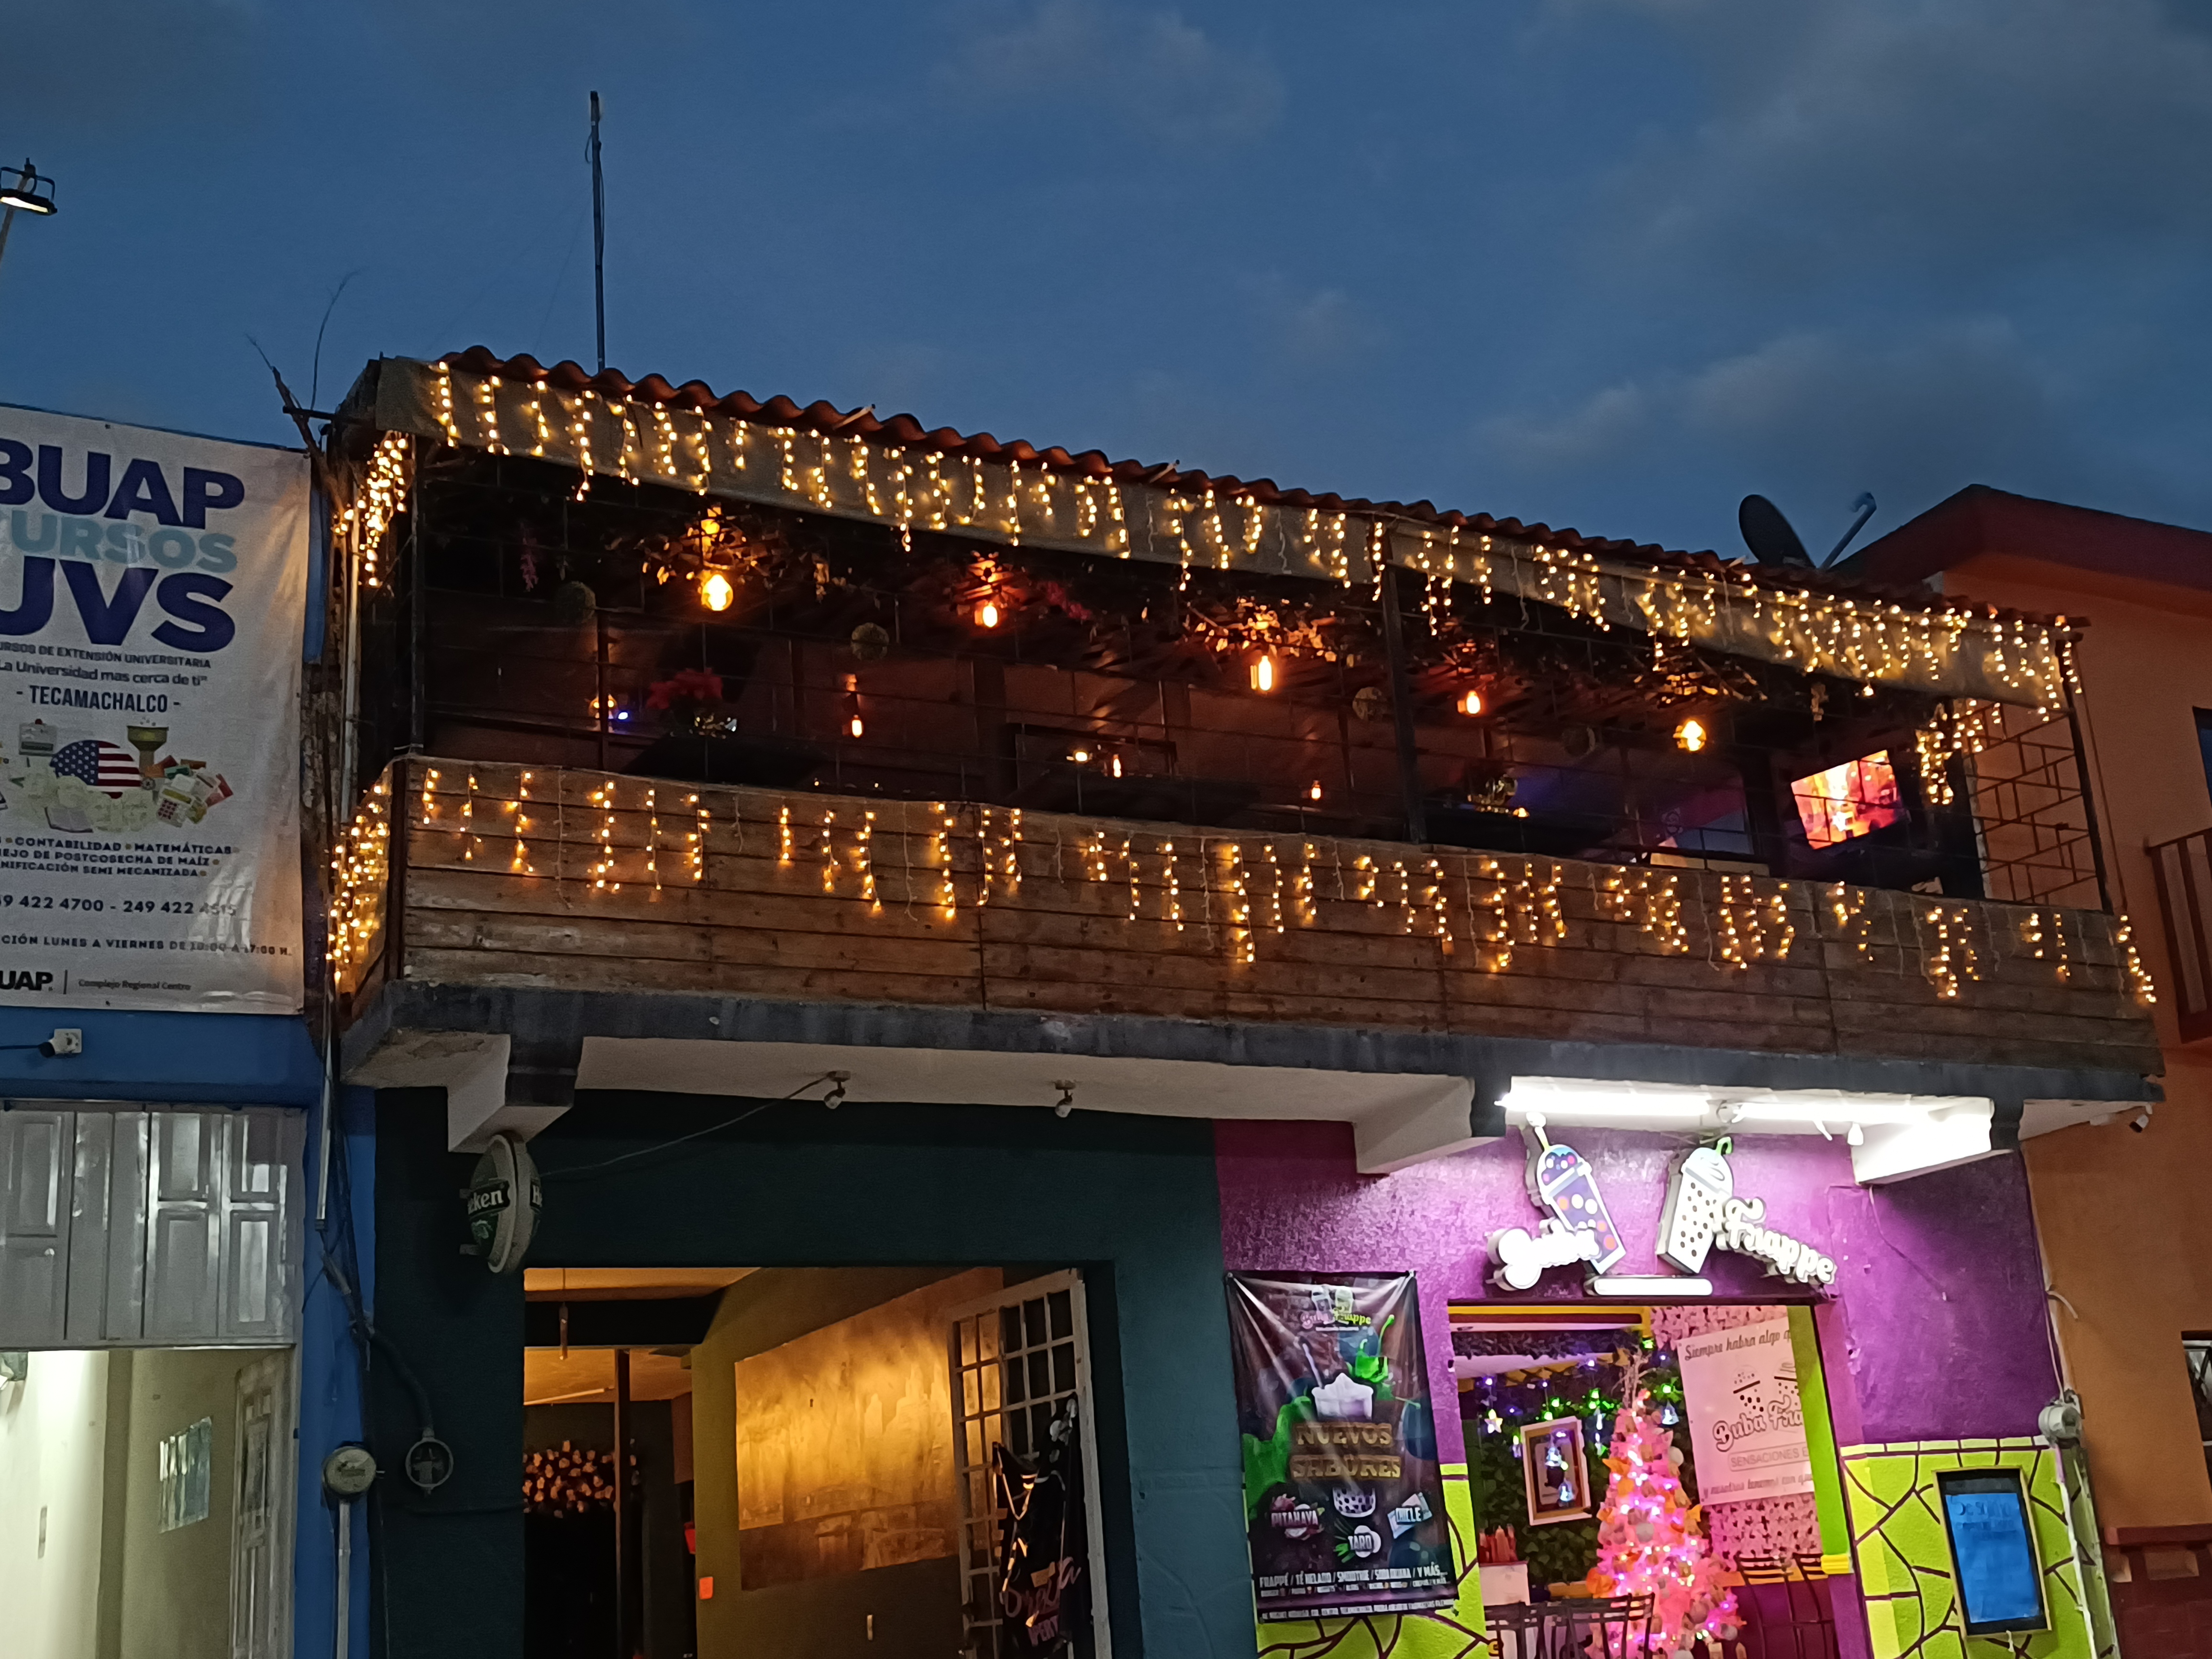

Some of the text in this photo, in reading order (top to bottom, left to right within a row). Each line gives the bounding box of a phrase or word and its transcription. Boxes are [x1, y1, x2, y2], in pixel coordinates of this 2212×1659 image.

[0, 438, 245, 530] BUAP
[125, 654, 211, 668] UNIVERSITARIA
[16, 661, 98, 680] Universidad
[30, 685, 167, 712] TECAMACHALCO
[15, 837, 231, 854] CONTABILIDAD MATEMÁTICAS
[0, 848, 210, 866] EJO DE POSTCOSECHA DE MAÍZ
[83, 866, 112, 874] SEMI
[117, 867, 198, 876] MECANIZADA
[19, 896, 53, 909] 422
[59, 898, 104, 912] 4700
[123, 901, 155, 913] 249
[160, 901, 194, 914] 422
[44, 936, 87, 948] LUNES
[92, 939, 101, 948] A
[106, 939, 164, 950] VIERNES
[1684, 1343, 1723, 1361] Siempre
[1759, 1329, 1781, 1346] algo
[1712, 1412, 1768, 1452] Buba
[1730, 1448, 1800, 1468] SENSACIONES
[1348, 1535, 1372, 1550] TARO
